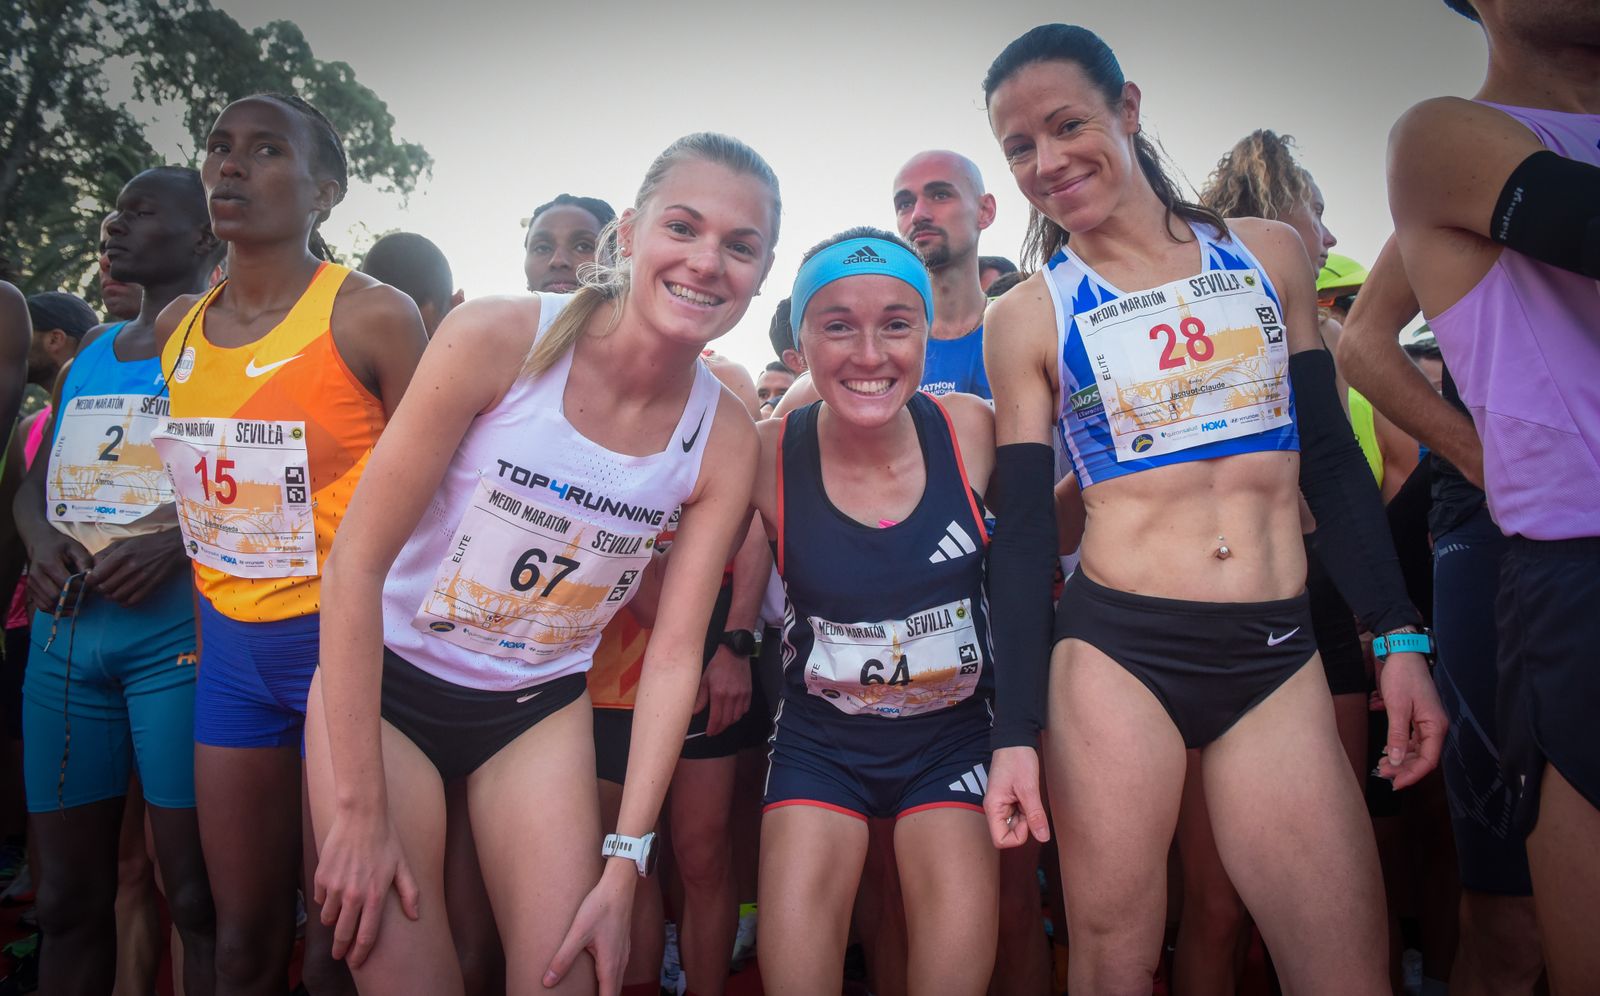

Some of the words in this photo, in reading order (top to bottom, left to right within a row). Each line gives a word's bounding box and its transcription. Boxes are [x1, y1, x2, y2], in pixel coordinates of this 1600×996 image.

[842, 255, 887, 265] adidas
[1189, 272, 1244, 298] SEVILLA
[1089, 304, 1119, 327] MEDIO
[1119, 290, 1167, 314] MARATÓN
[1149, 316, 1215, 371] 28
[1096, 354, 1111, 381] ELITE
[75, 399, 92, 410] MEDIO
[95, 395, 125, 410] MARATÓN
[1071, 390, 1100, 410] Mos
[1170, 382, 1226, 400] Jacquot-Claude
[140, 397, 170, 417] SEVIL
[167, 422, 184, 436] MEDIO
[185, 420, 215, 437] MARATÓN
[235, 422, 284, 445] SEVILLA
[1201, 419, 1228, 432] HOKA
[98, 425, 124, 462] 2
[194, 456, 238, 505] 15
[497, 459, 665, 526] TOP4RUNNING
[94, 506, 116, 515] HOKA
[489, 489, 522, 516] MEDIO
[521, 506, 572, 535] MARATÓN
[452, 534, 472, 564] ELITE
[591, 530, 643, 555] SEVILLA
[220, 553, 238, 565] HOKA
[510, 547, 581, 598] 67
[818, 621, 845, 636] MEDIO
[845, 623, 887, 639] MARATÓN
[905, 608, 954, 637] SEVILLA
[498, 639, 526, 650] HOKA
[860, 654, 914, 687] 64
